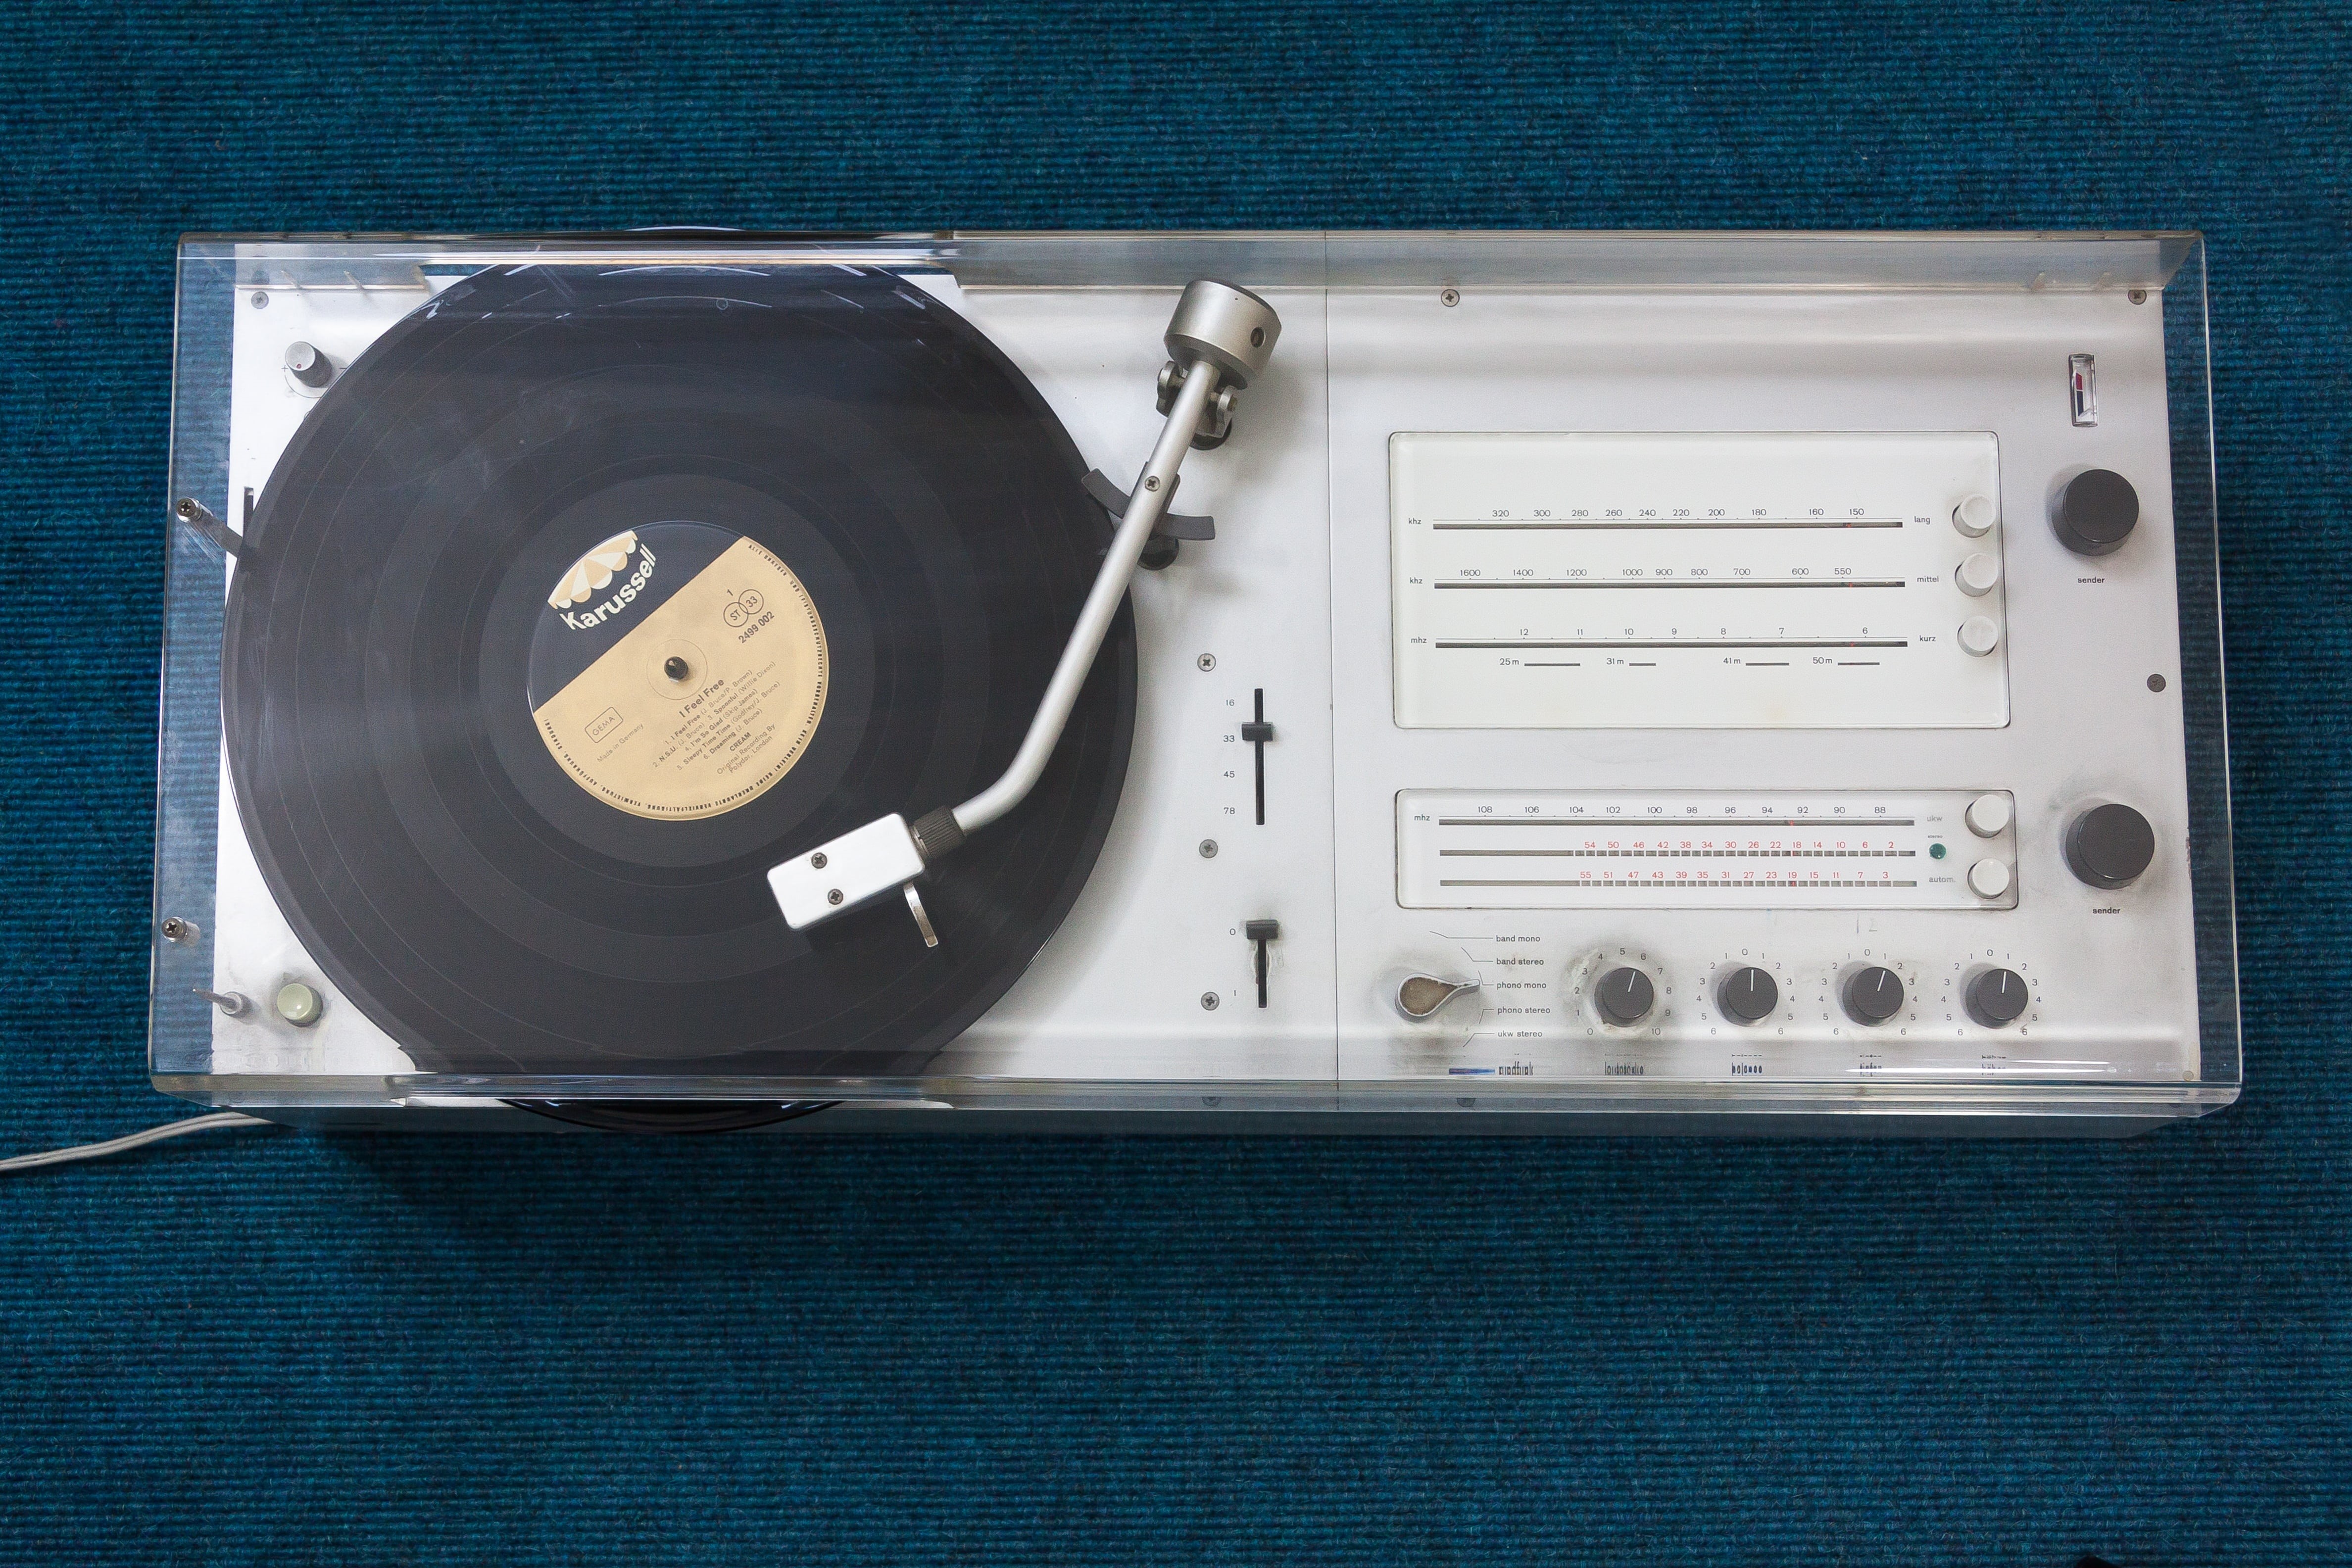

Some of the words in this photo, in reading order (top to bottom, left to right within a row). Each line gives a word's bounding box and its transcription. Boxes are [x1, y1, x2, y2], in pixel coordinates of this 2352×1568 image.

[1914, 516, 1930, 525] lang
[559, 543, 656, 630] Karussell
[746, 596, 757, 607] 33
[730, 609, 740, 621] ST
[738, 624, 758, 643] 2499
[758, 611, 774, 626] 002
[684, 694, 704, 713] Feel
[703, 680, 724, 697] Free
[714, 692, 738, 715] Spoonful
[592, 717, 615, 735] GEMA
[619, 724, 643, 744] Germany
[675, 725, 687, 737] Feel
[687, 715, 700, 726] Free
[709, 718, 723, 730] Glad
[702, 736, 716, 747] Time
[716, 724, 731, 735] Time
[709, 732, 736, 754] Dreaming
[730, 732, 751, 751] CREAM
[751, 736, 773, 753] London
[717, 754, 739, 774] Original
[739, 732, 768, 755] Recording
[1498, 1006, 1522, 1015] phono
